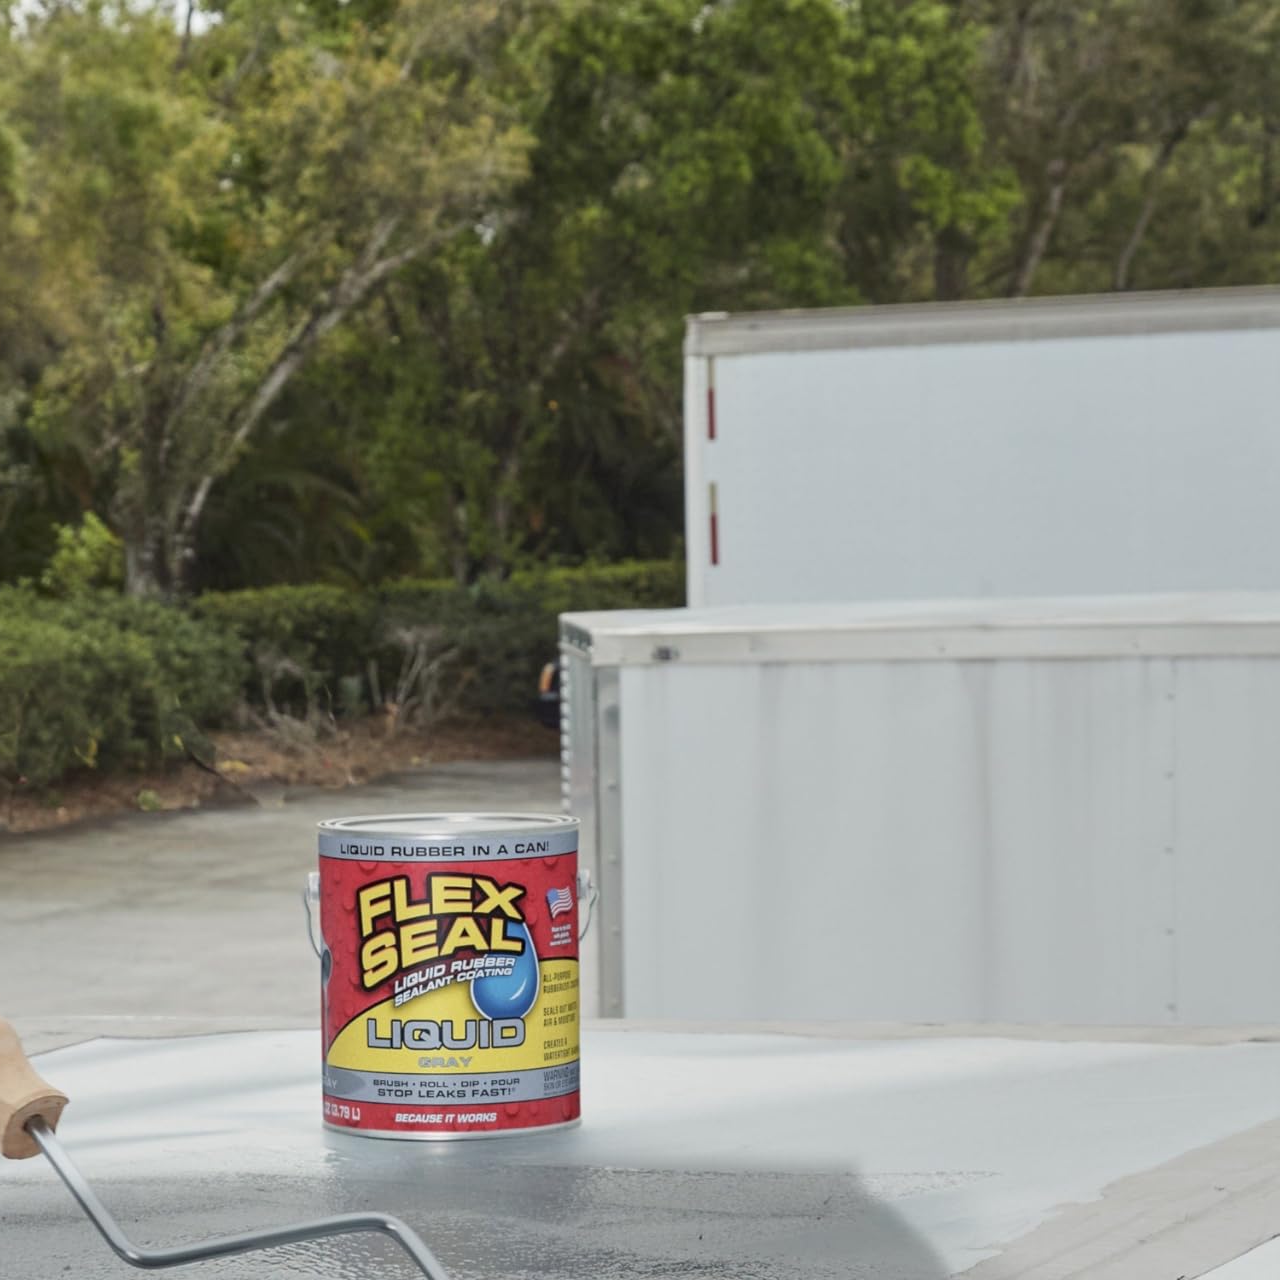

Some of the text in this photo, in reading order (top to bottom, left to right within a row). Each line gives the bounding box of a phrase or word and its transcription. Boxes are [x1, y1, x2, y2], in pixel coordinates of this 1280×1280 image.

[340, 841, 549, 857] LIQUID RUBBER IN A CAN!
[358, 875, 524, 938] FLEX
[361, 916, 523, 989] SEAL
[394, 954, 516, 994] LIQUID RUBBER
[394, 968, 513, 1007] SEALANT COATING
[367, 1018, 525, 1050] LIQUID
[418, 1057, 472, 1067] GRAY
[373, 1079, 408, 1087] BRUSH
[378, 1088, 413, 1097] STOP
[418, 1090, 466, 1098] LEAKS
[395, 1112, 497, 1123] BECAUSE IT WORKS
